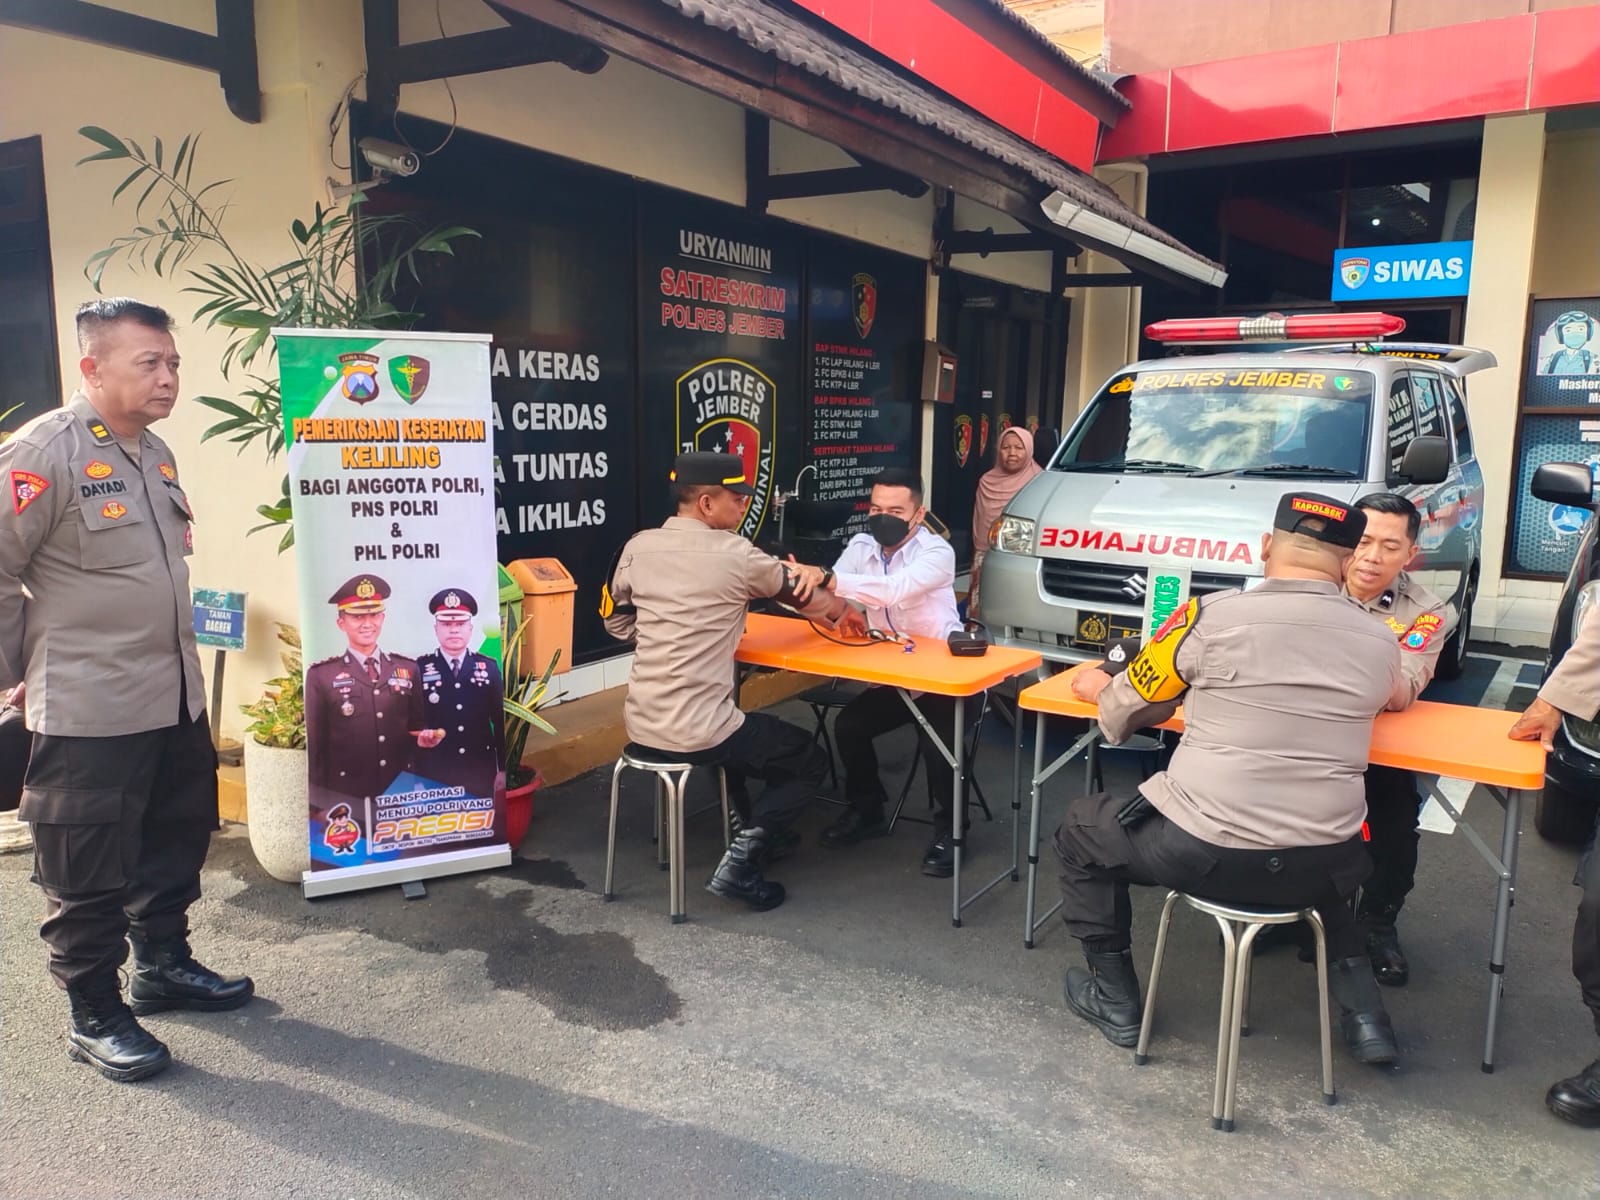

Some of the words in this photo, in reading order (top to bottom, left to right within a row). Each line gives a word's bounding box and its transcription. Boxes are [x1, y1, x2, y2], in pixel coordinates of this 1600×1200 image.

[680, 229, 771, 270] URYANMIN
[1373, 257, 1464, 283] SIWAS
[660, 266, 785, 313] SATRESKRIM
[661, 302, 726, 333] POLRES
[729, 312, 785, 339] JEMBER
[518, 349, 600, 382] KERAS
[821, 357, 829, 366] FC
[821, 368, 829, 377] FC
[1138, 371, 1226, 391] POLRES
[1229, 370, 1327, 391] JEMBER
[688, 369, 767, 404] POLRES
[821, 380, 829, 389] FC
[830, 380, 842, 389] KTP
[512, 402, 608, 431] CERDAS
[695, 395, 761, 424] JEMBER
[820, 409, 829, 418] FC
[830, 409, 842, 418] LAP
[292, 417, 400, 443] PEMERIKSAAN
[401, 418, 487, 443] KESEHATAN
[820, 420, 829, 429] FC
[820, 431, 829, 440] FC
[830, 431, 842, 440] KTP
[340, 445, 442, 470] KELILING
[512, 451, 609, 483] TUNTAS
[820, 460, 828, 468] FC
[829, 459, 841, 468] KTP
[820, 470, 828, 479] FC
[81, 479, 127, 498] DAYADI
[300, 479, 340, 496] BAGI
[346, 478, 427, 495] ANGGOTA
[432, 477, 485, 496] POLRI,
[819, 480, 834, 490] DARI
[819, 492, 828, 501] FC
[828, 489, 856, 500] LAPORAN
[351, 501, 385, 518] PNS
[389, 500, 439, 517] POLRI
[518, 499, 606, 534] IKHLAS
[1295, 501, 1343, 519] KAPOLSEK
[390, 522, 402, 538] &
[354, 544, 387, 561] PHL
[392, 543, 440, 559] POLRI
[209, 609, 232, 620] TAMAN
[376, 786, 465, 807] TRANSFORMASI
[377, 805, 424, 820] MENUJU
[426, 801, 460, 814] POLRI
[460, 797, 493, 810] YANG
[373, 809, 495, 843] PRESISI
